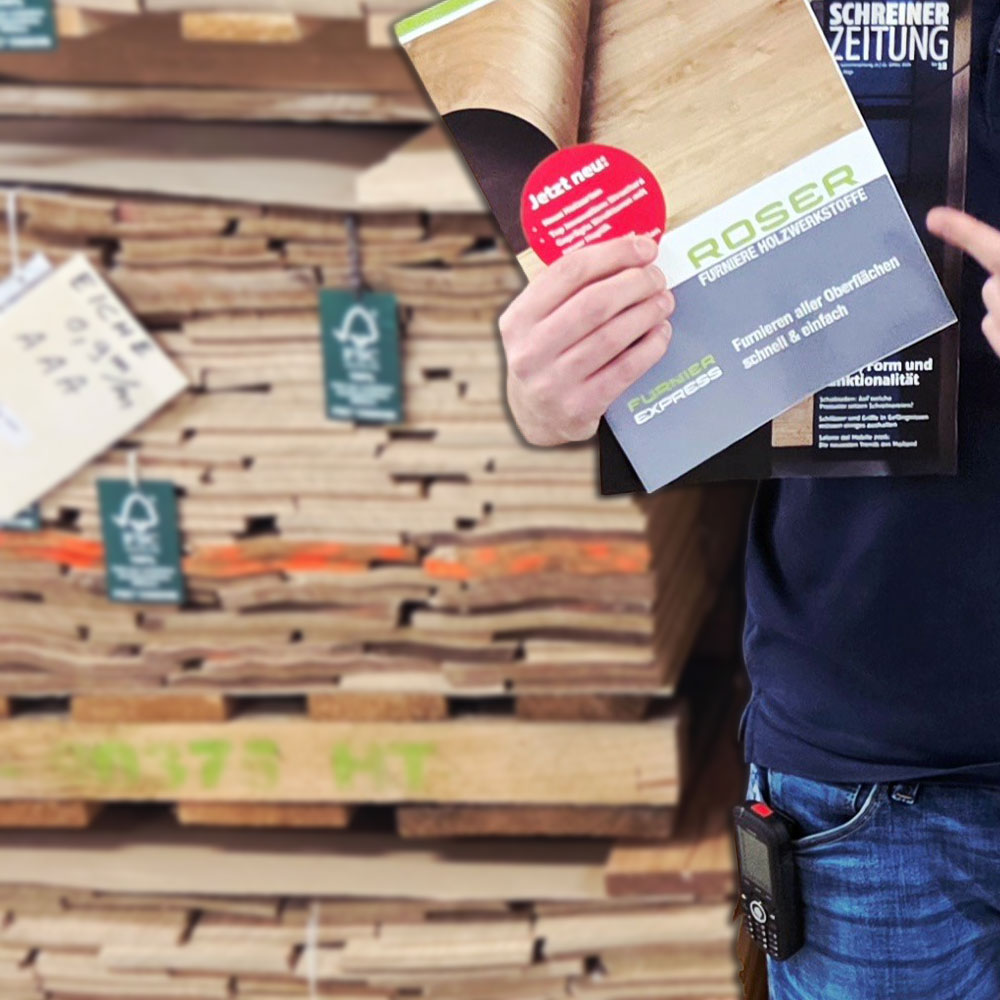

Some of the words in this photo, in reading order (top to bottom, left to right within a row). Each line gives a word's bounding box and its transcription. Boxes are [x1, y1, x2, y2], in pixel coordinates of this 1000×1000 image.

[829, 1, 950, 26] SCHREINER
[829, 25, 949, 62] ZEITUNG
[528, 176, 573, 211] Jetzt
[687, 164, 859, 270] ROSER
[698, 245, 760, 287] FURNIERE
[757, 186, 869, 254] HOLZWERKSTOFFE
[731, 312, 794, 352] Furnieren
[794, 296, 823, 320] aller
[823, 255, 901, 303] Oberflächen
[742, 335, 789, 369] schnell
[788, 329, 801, 345] &
[801, 303, 849, 337] einfach
[826, 373, 920, 387] nktionalität
[904, 357, 933, 371] und
[634, 366, 723, 425] EXPRESS
